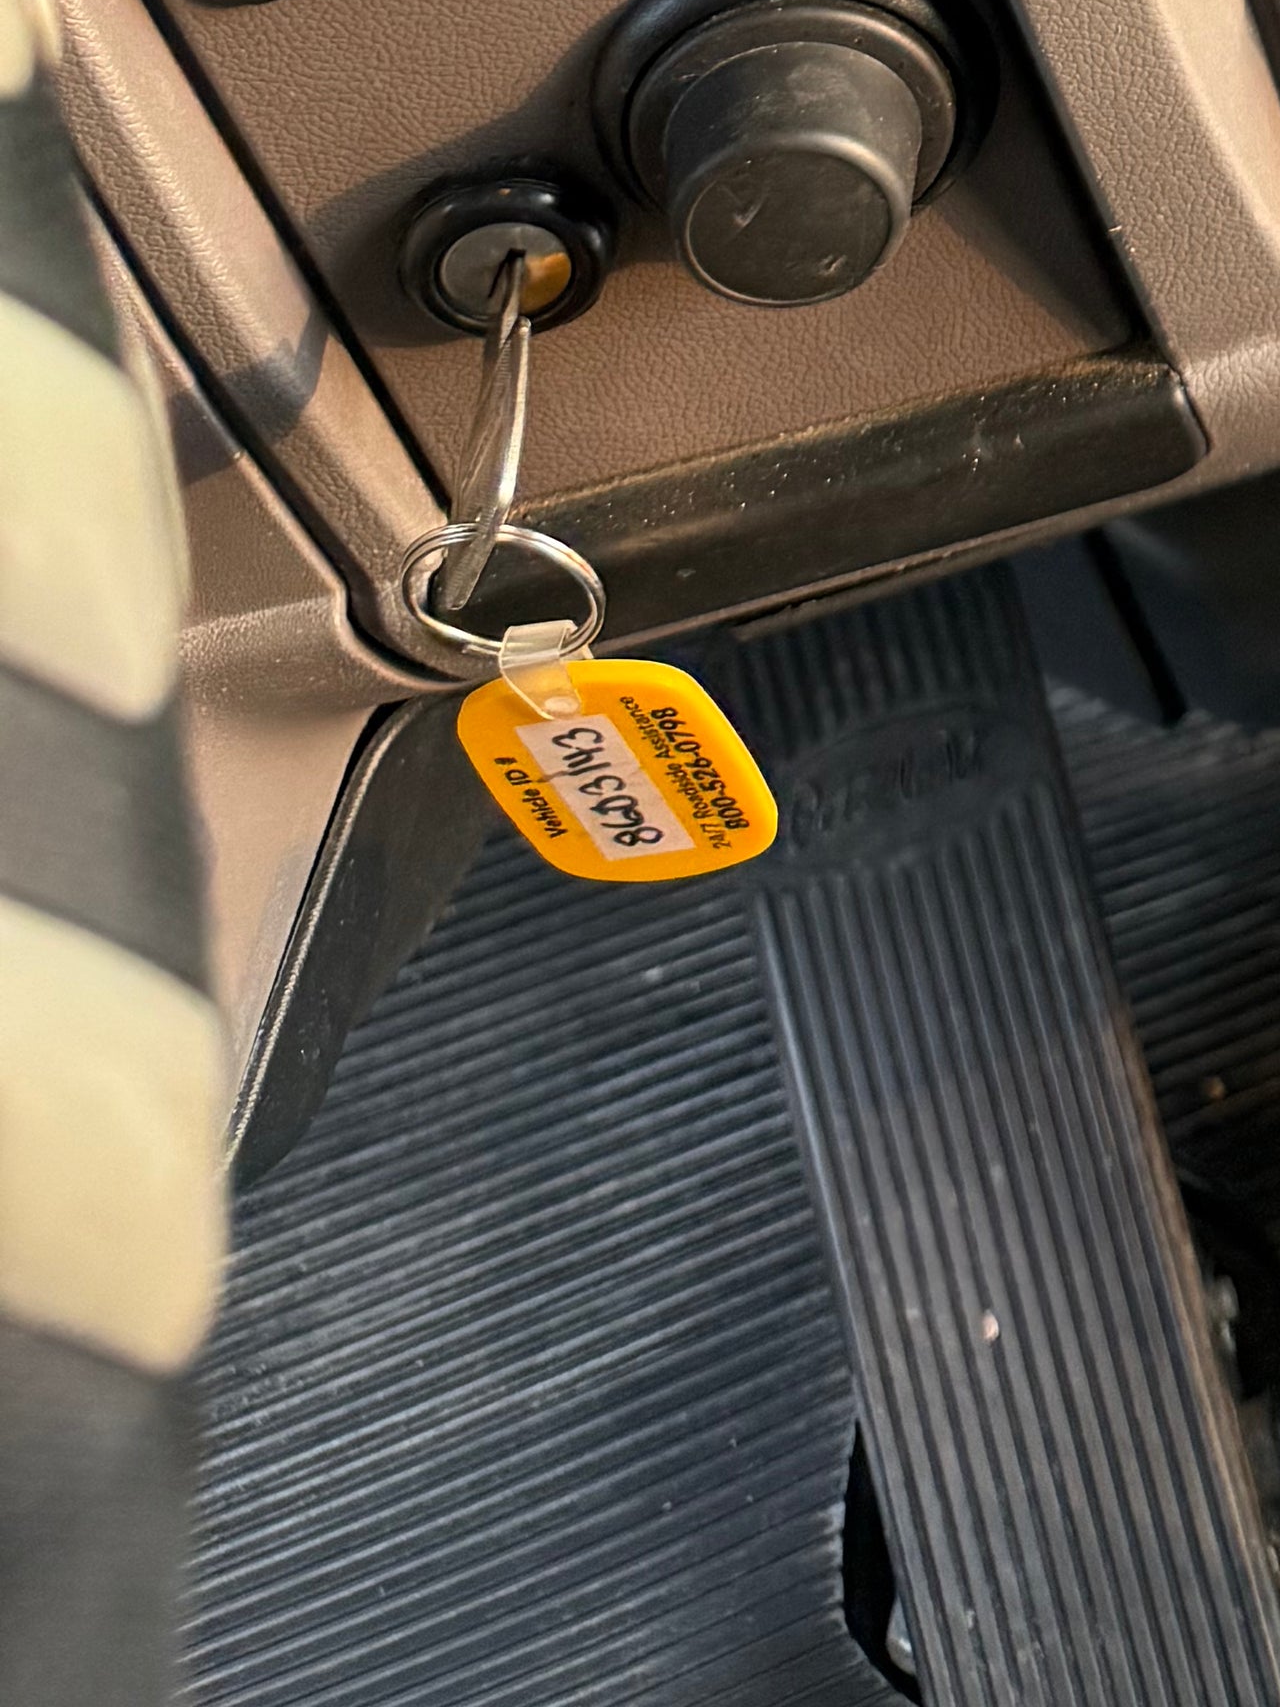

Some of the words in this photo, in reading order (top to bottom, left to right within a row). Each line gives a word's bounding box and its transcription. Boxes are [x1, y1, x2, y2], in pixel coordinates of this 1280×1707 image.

[618, 696, 672, 761] Assistance
[504, 769, 533, 789] ID
[650, 706, 751, 831] 800-526-0798
[665, 761, 710, 821] Roadside
[522, 788, 567, 838] Vehicle
